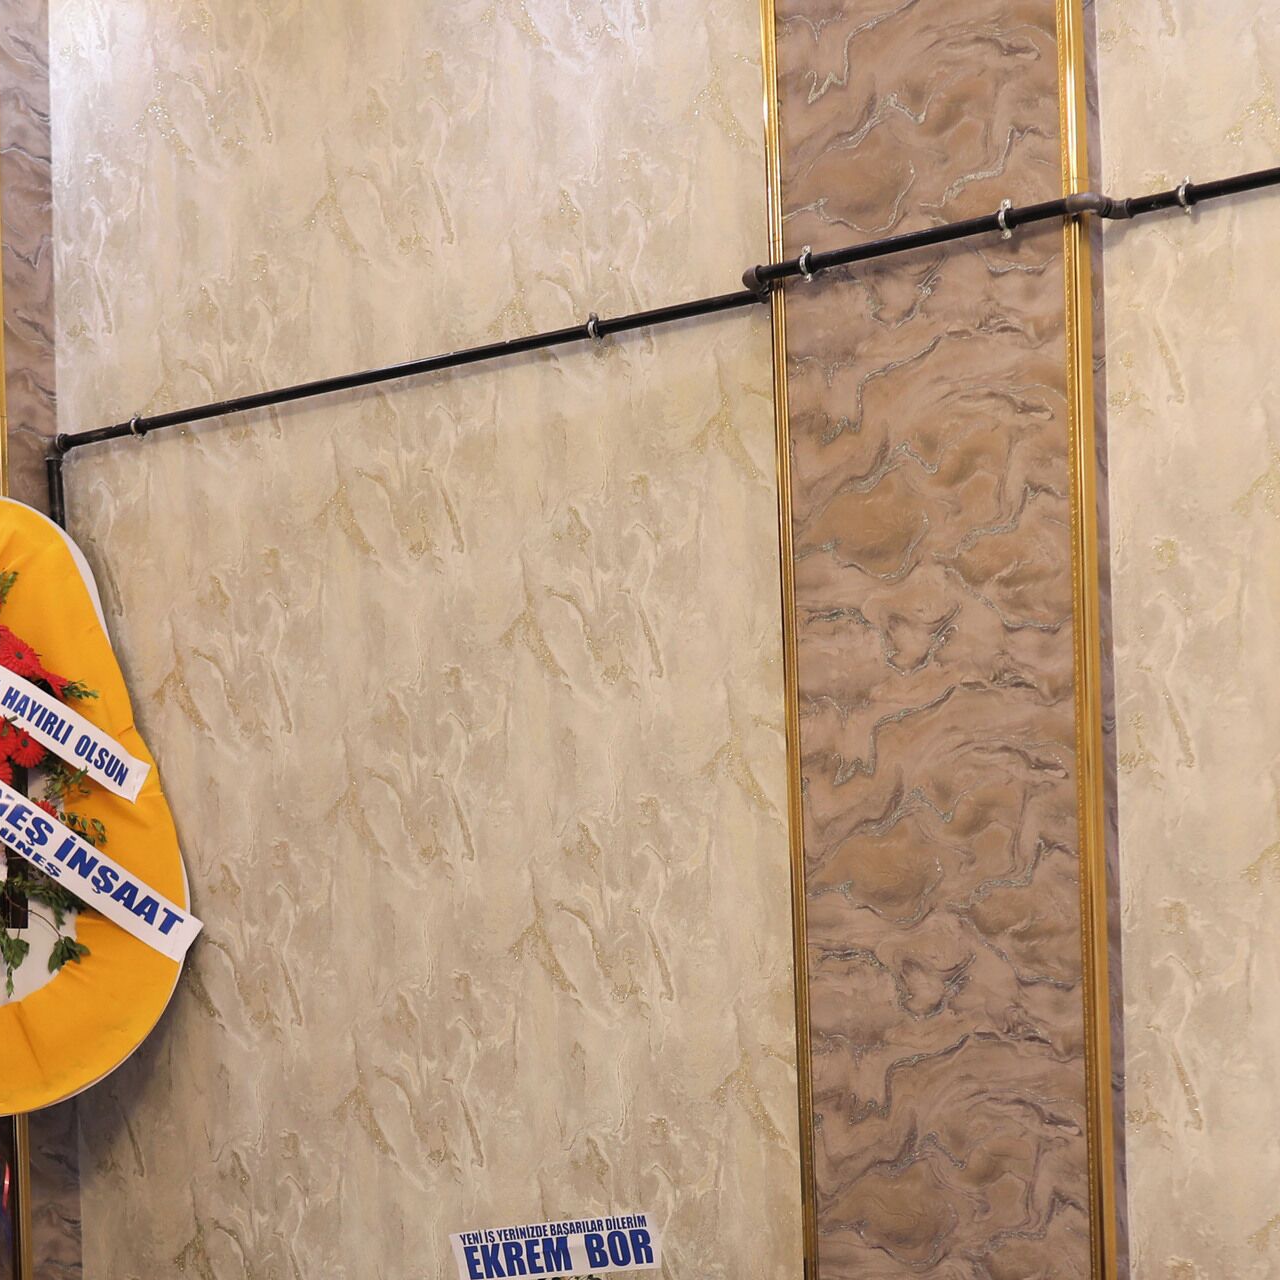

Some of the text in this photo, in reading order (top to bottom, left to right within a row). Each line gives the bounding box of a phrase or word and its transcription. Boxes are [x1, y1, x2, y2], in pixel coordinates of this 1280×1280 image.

[1, 686, 74, 746] HAYIRLI
[74, 734, 129, 787] OLSUN
[53, 835, 184, 935] İNŞAAT
[460, 1229, 483, 1246] YENİ
[496, 1224, 549, 1242] YERİNİZDE
[549, 1219, 604, 1237] BAŞARILAR
[605, 1213, 648, 1231] DİLERİM
[463, 1228, 654, 1280] EKREM BOR
